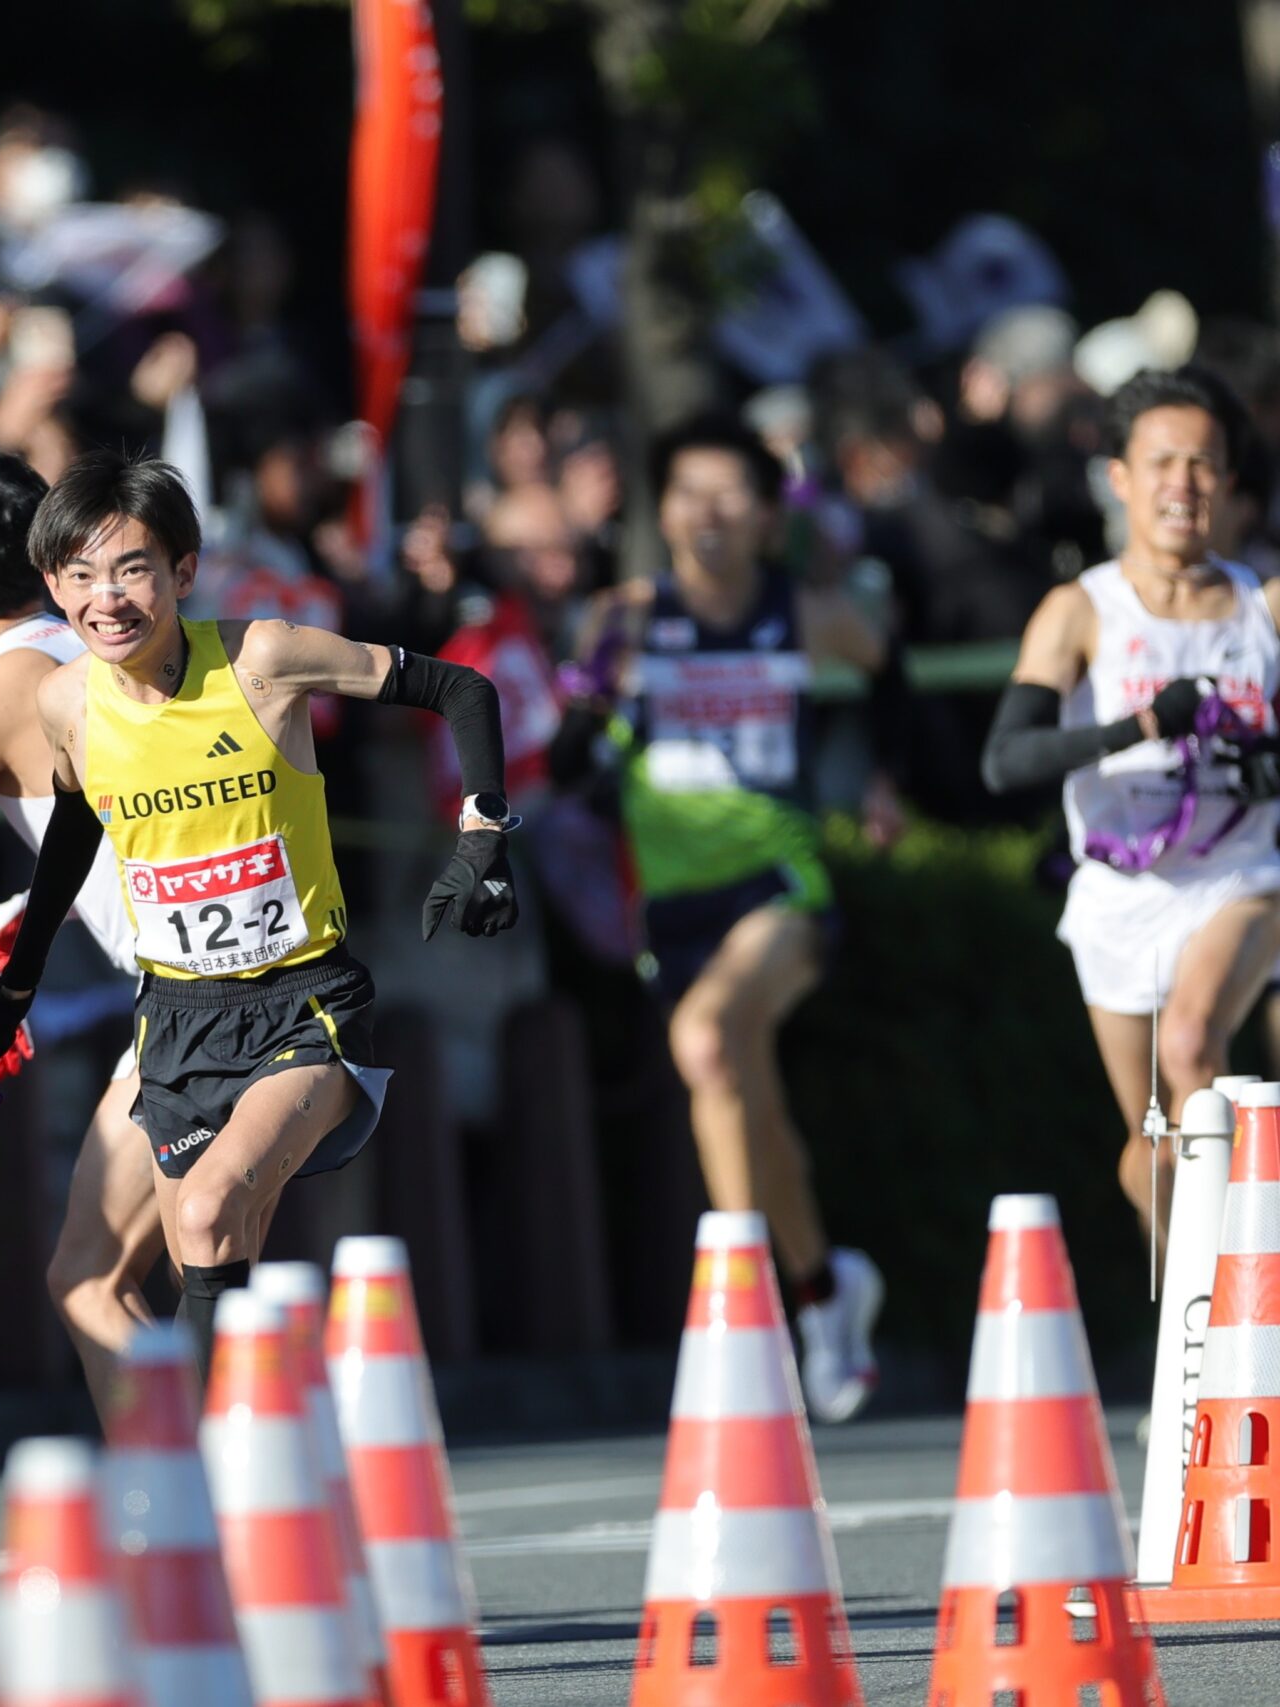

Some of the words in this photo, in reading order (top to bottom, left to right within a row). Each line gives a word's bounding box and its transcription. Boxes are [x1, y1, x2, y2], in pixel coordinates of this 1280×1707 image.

[118, 769, 277, 820] LOGISTEED
[159, 853, 275, 897] ヤマザキ
[167, 899, 290, 954] 12-2
[170, 1127, 217, 1156] LOGIS
